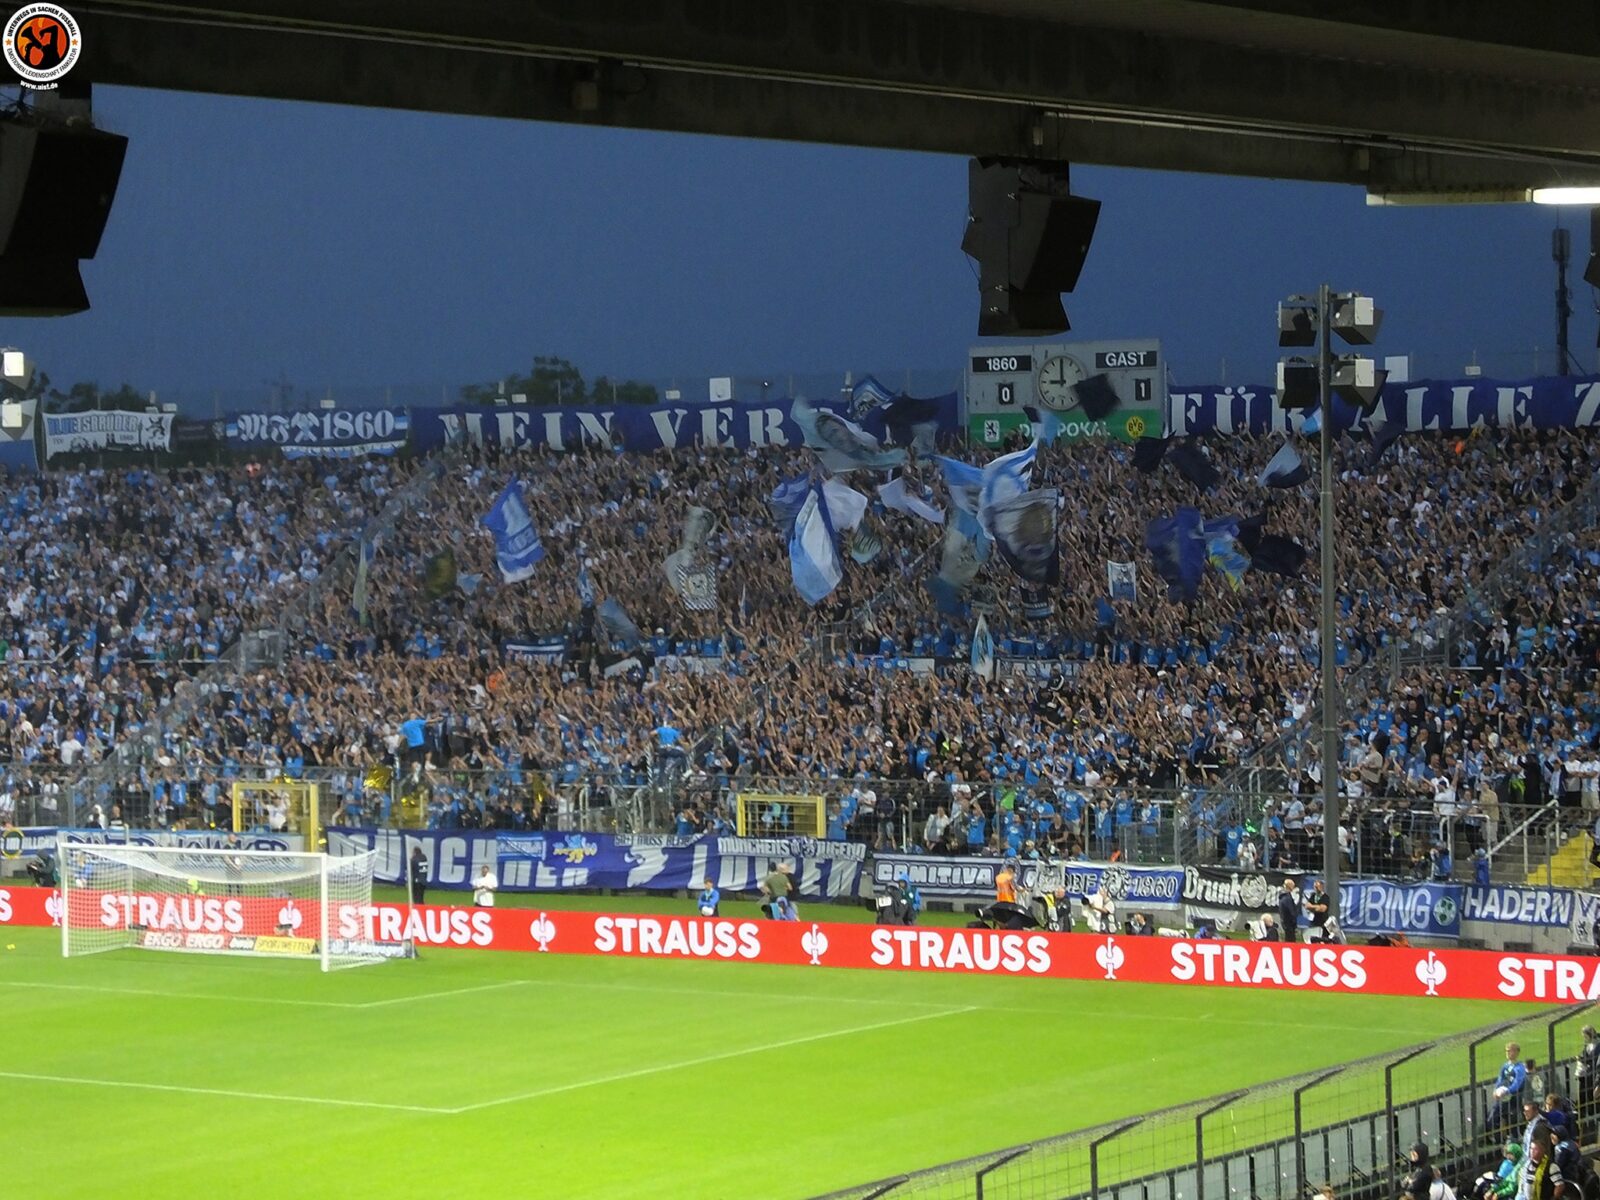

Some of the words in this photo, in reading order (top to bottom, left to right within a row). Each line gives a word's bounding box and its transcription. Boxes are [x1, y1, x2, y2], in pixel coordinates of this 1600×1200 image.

[986, 357, 1017, 371] 1860
[1105, 352, 1147, 367] GAST
[1002, 388, 1010, 401] 0
[321, 409, 395, 441] 1860
[438, 411, 615, 450] MEIN
[1133, 875, 1178, 899] 1860
[1182, 865, 1241, 906] Drunk
[100, 894, 244, 933] STRAUSS
[1463, 887, 1571, 924] HADERN
[144, 932, 182, 948] ERGO
[185, 933, 225, 949] ERGO
[338, 904, 494, 947] STRAUSS
[594, 916, 761, 960] STRAUSS
[870, 928, 1051, 974] STRAUSS
[1170, 942, 1367, 989] STRAUSS
